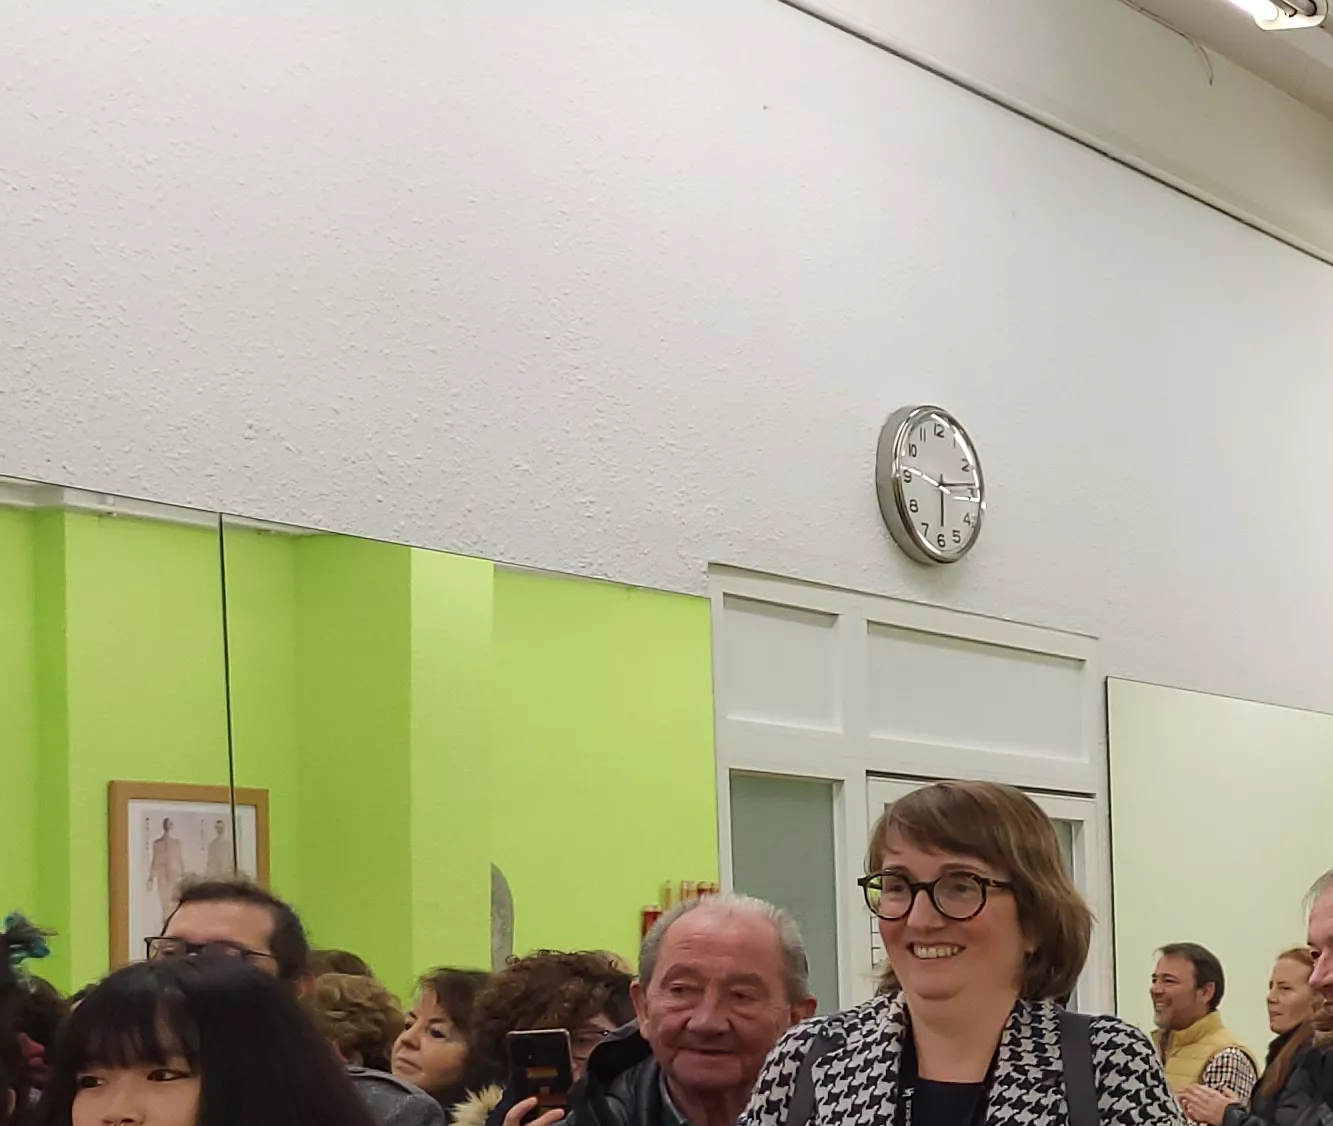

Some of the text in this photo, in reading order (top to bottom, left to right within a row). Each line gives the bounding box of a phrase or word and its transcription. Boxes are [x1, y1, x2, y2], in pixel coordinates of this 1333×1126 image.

[919, 426, 927, 442] 11
[933, 422, 945, 438] 12
[908, 442, 918, 458] 10
[961, 458, 971, 472] 2
[903, 469, 912, 483] 9
[909, 499, 919, 513] 8
[963, 512, 972, 526] 4
[921, 521, 929, 538] 7
[952, 529, 961, 543] 5
[937, 533, 946, 548] 6
